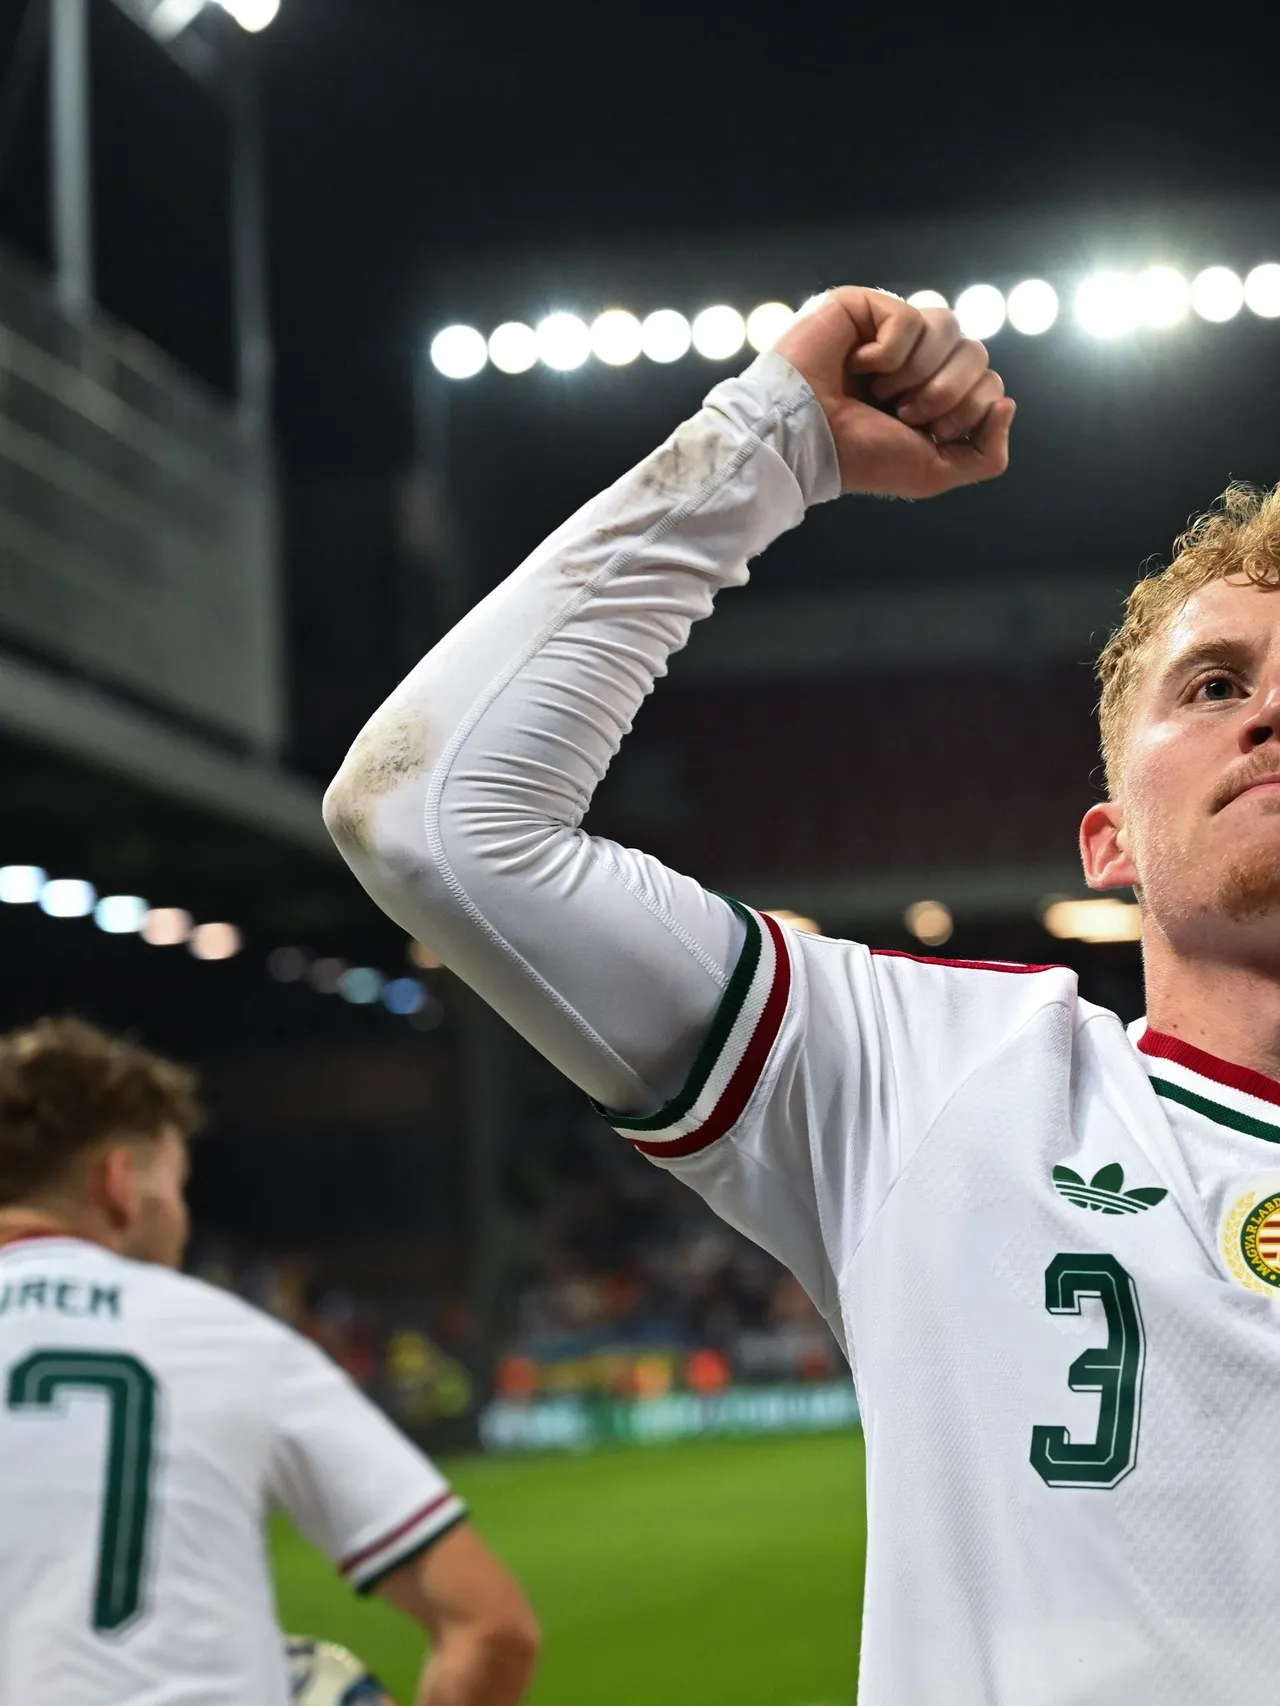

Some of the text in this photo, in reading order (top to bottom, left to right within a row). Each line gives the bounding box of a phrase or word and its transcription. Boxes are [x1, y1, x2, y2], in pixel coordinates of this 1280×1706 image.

[1242, 1224, 1271, 1276] MAGYAR
[1030, 1253, 1146, 1490] 3
[7, 1348, 162, 1639] 7
